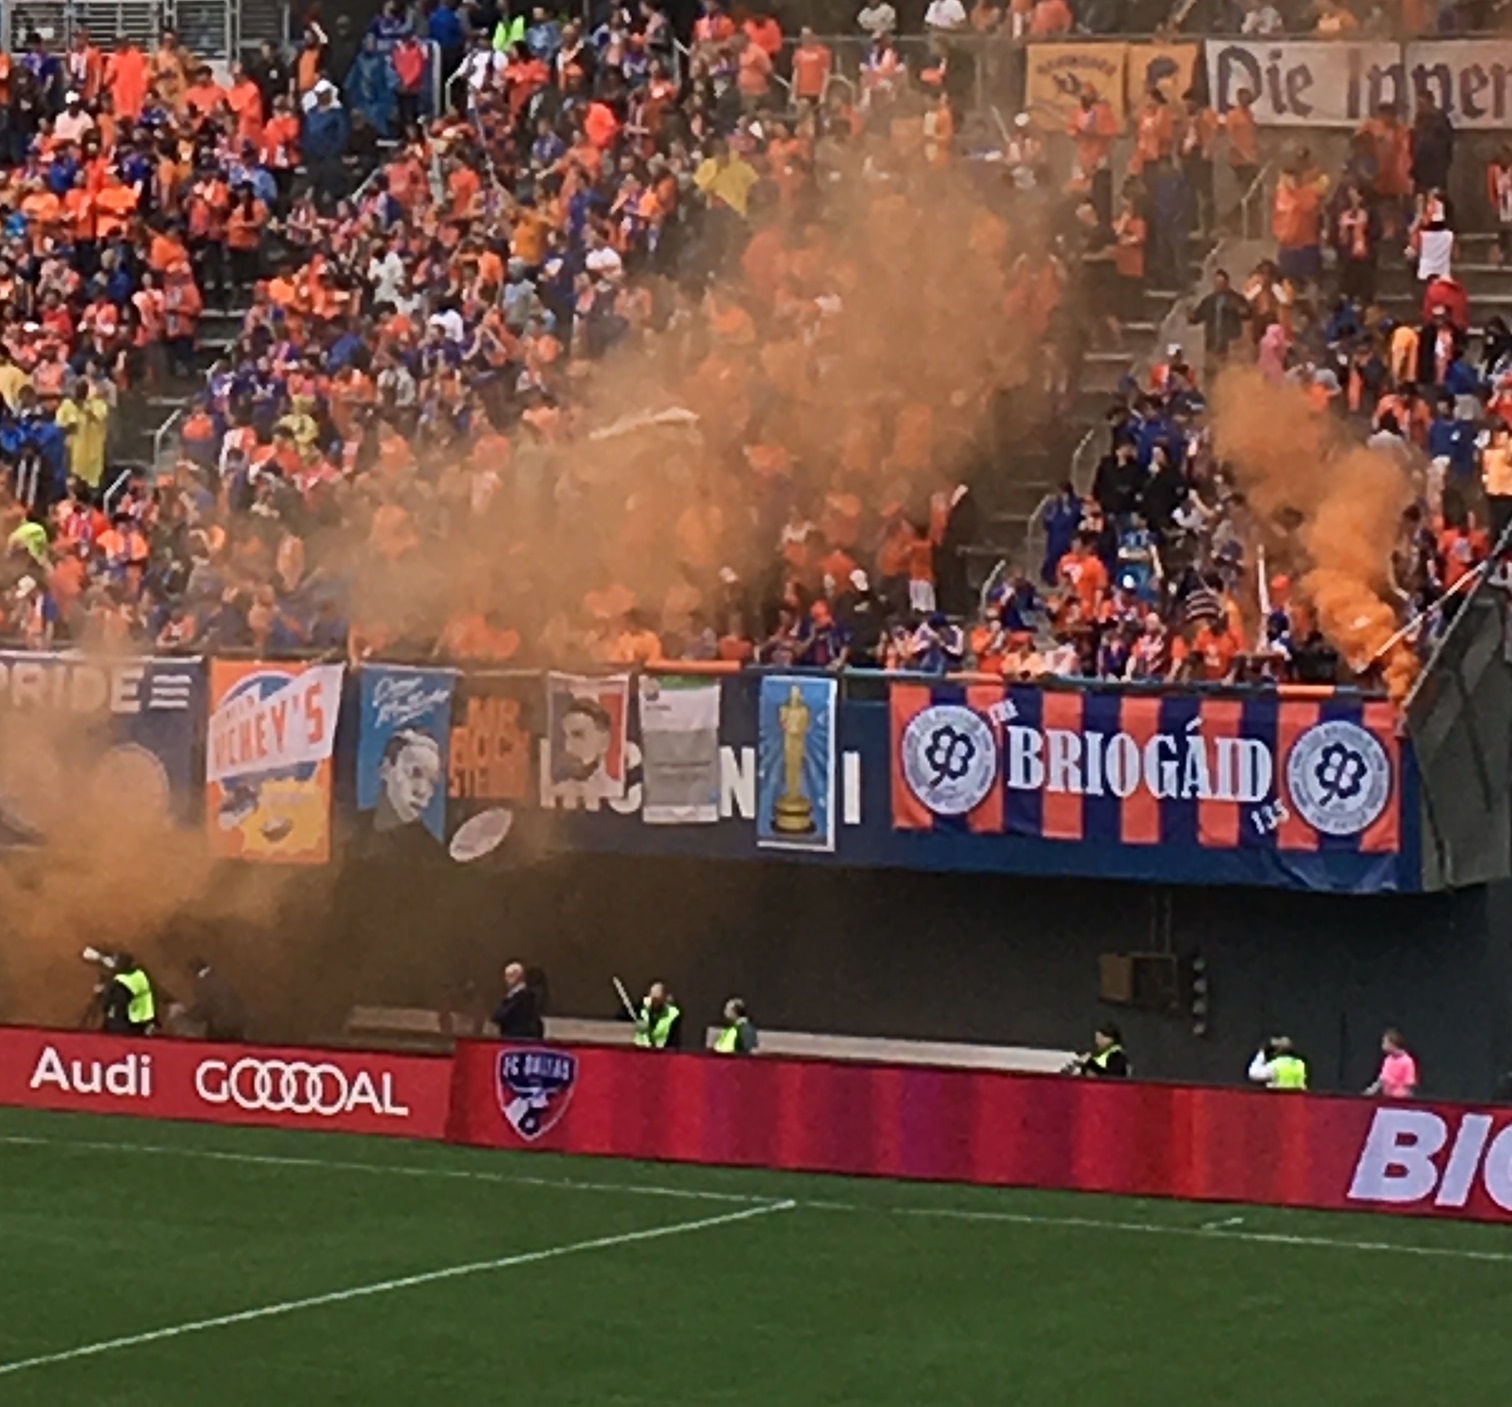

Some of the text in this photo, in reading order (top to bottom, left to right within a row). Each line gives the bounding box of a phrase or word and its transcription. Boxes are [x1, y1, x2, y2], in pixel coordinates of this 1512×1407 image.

[1217, 45, 1313, 117] Die
[1006, 716, 1273, 803] BRIOGÁID
[30, 1046, 151, 1096] Audi
